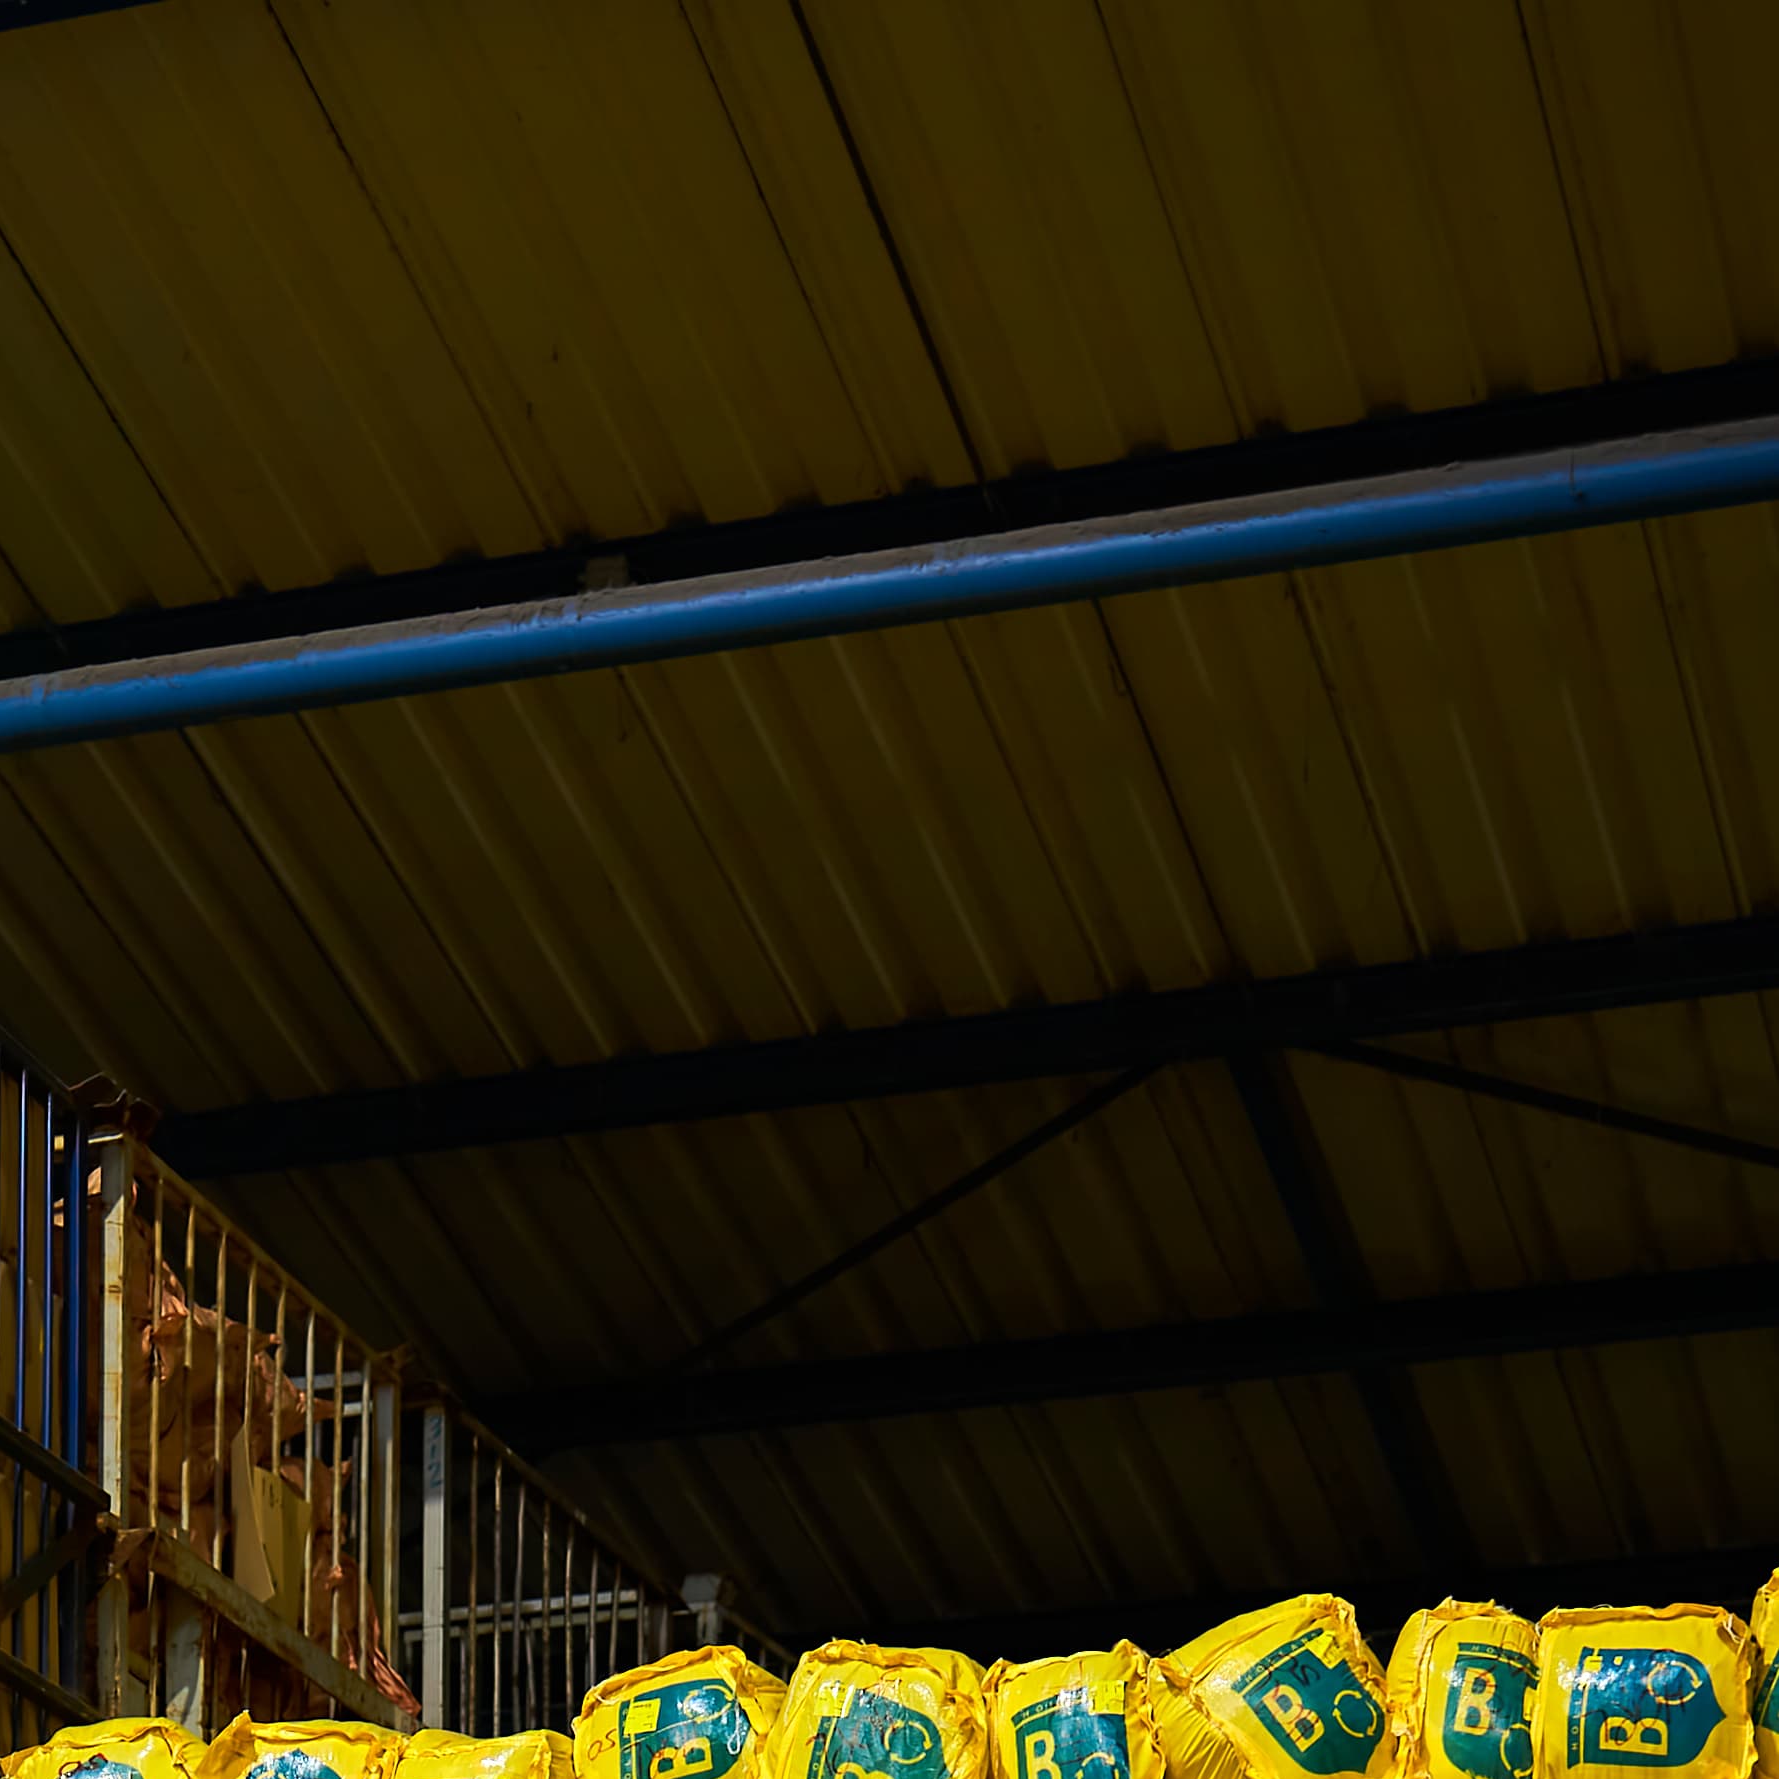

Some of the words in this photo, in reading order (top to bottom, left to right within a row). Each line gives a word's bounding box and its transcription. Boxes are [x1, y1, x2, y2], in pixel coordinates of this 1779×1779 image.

[1262, 1685, 1325, 1753] B
[1454, 1667, 1497, 1736] B
[1599, 1715, 1668, 1756] B
